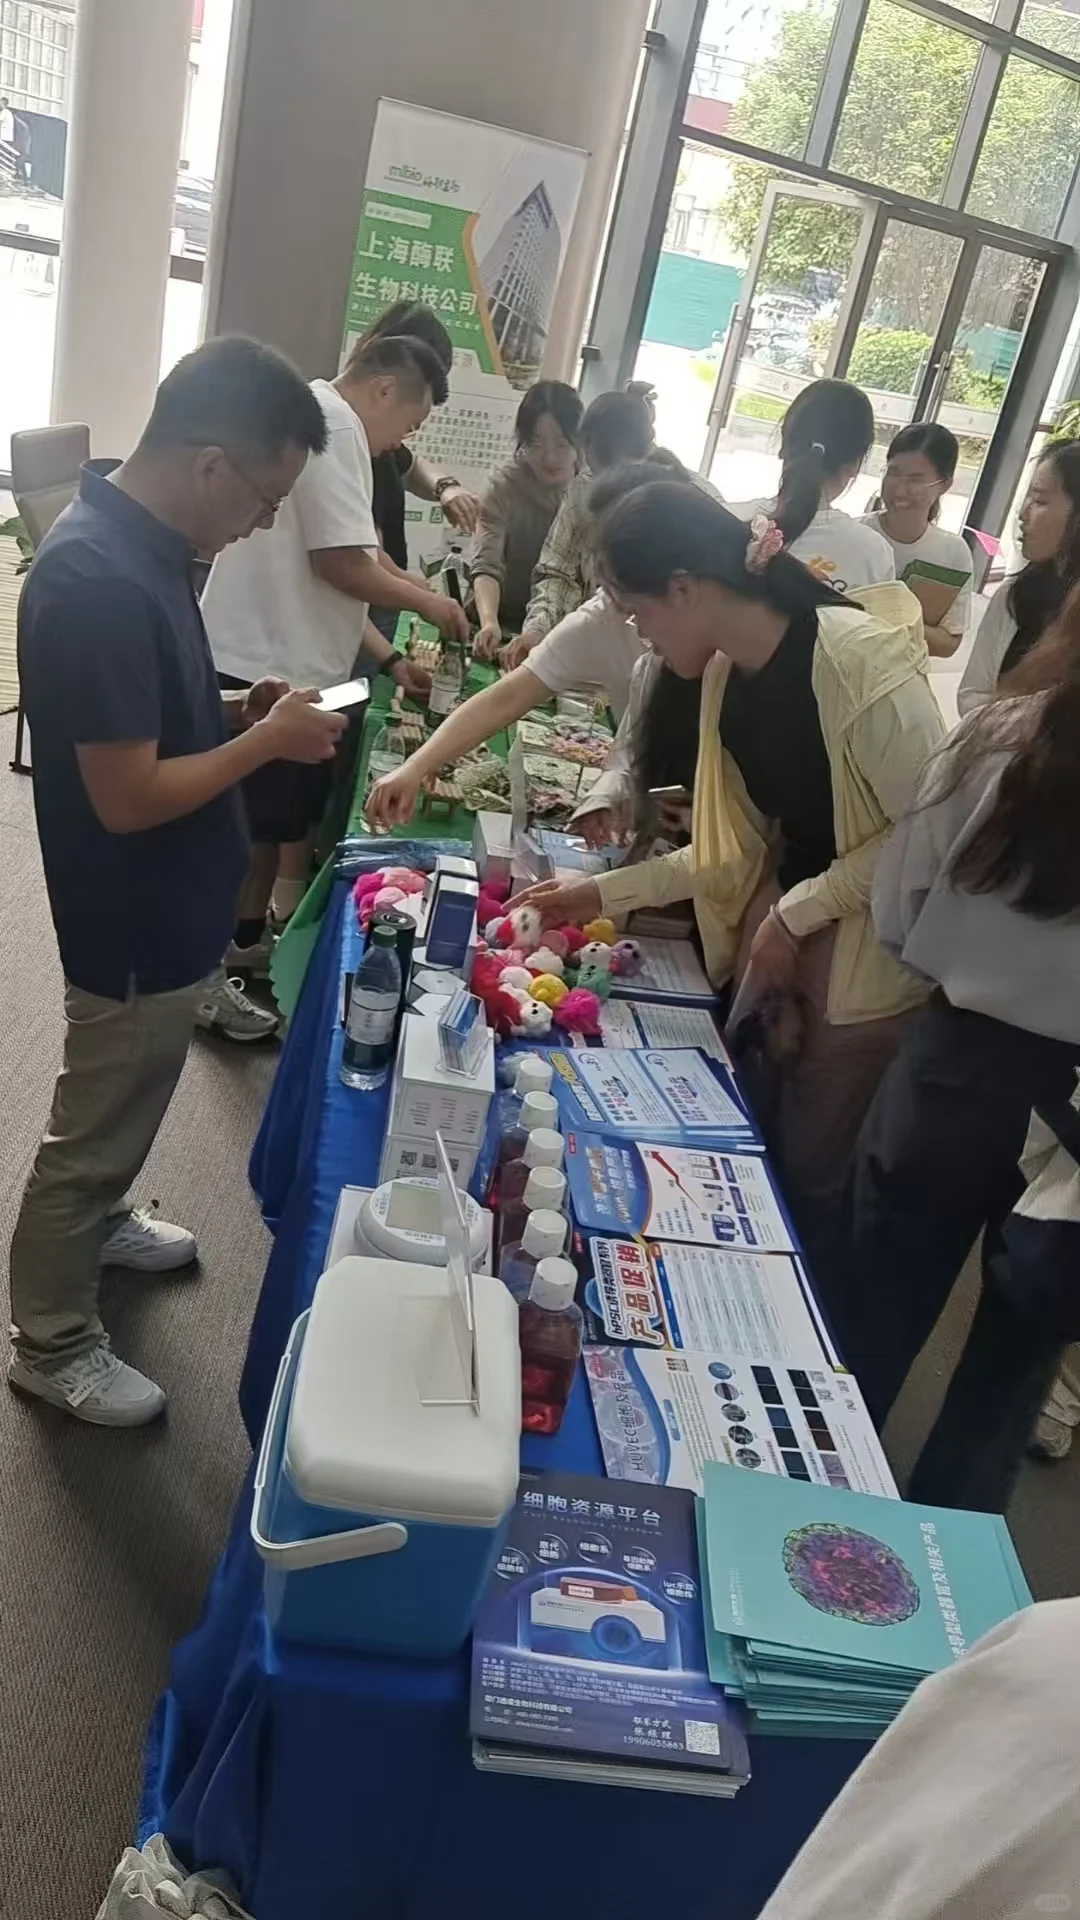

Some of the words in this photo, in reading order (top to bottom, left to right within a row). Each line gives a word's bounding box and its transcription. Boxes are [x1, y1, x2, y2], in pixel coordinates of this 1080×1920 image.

[359, 231, 455, 273] 上海酶联
[354, 272, 478, 315] 生物科技公司
[615, 1243, 657, 1340] 产品促销
[523, 1491, 661, 1527] 细胞资源平台
